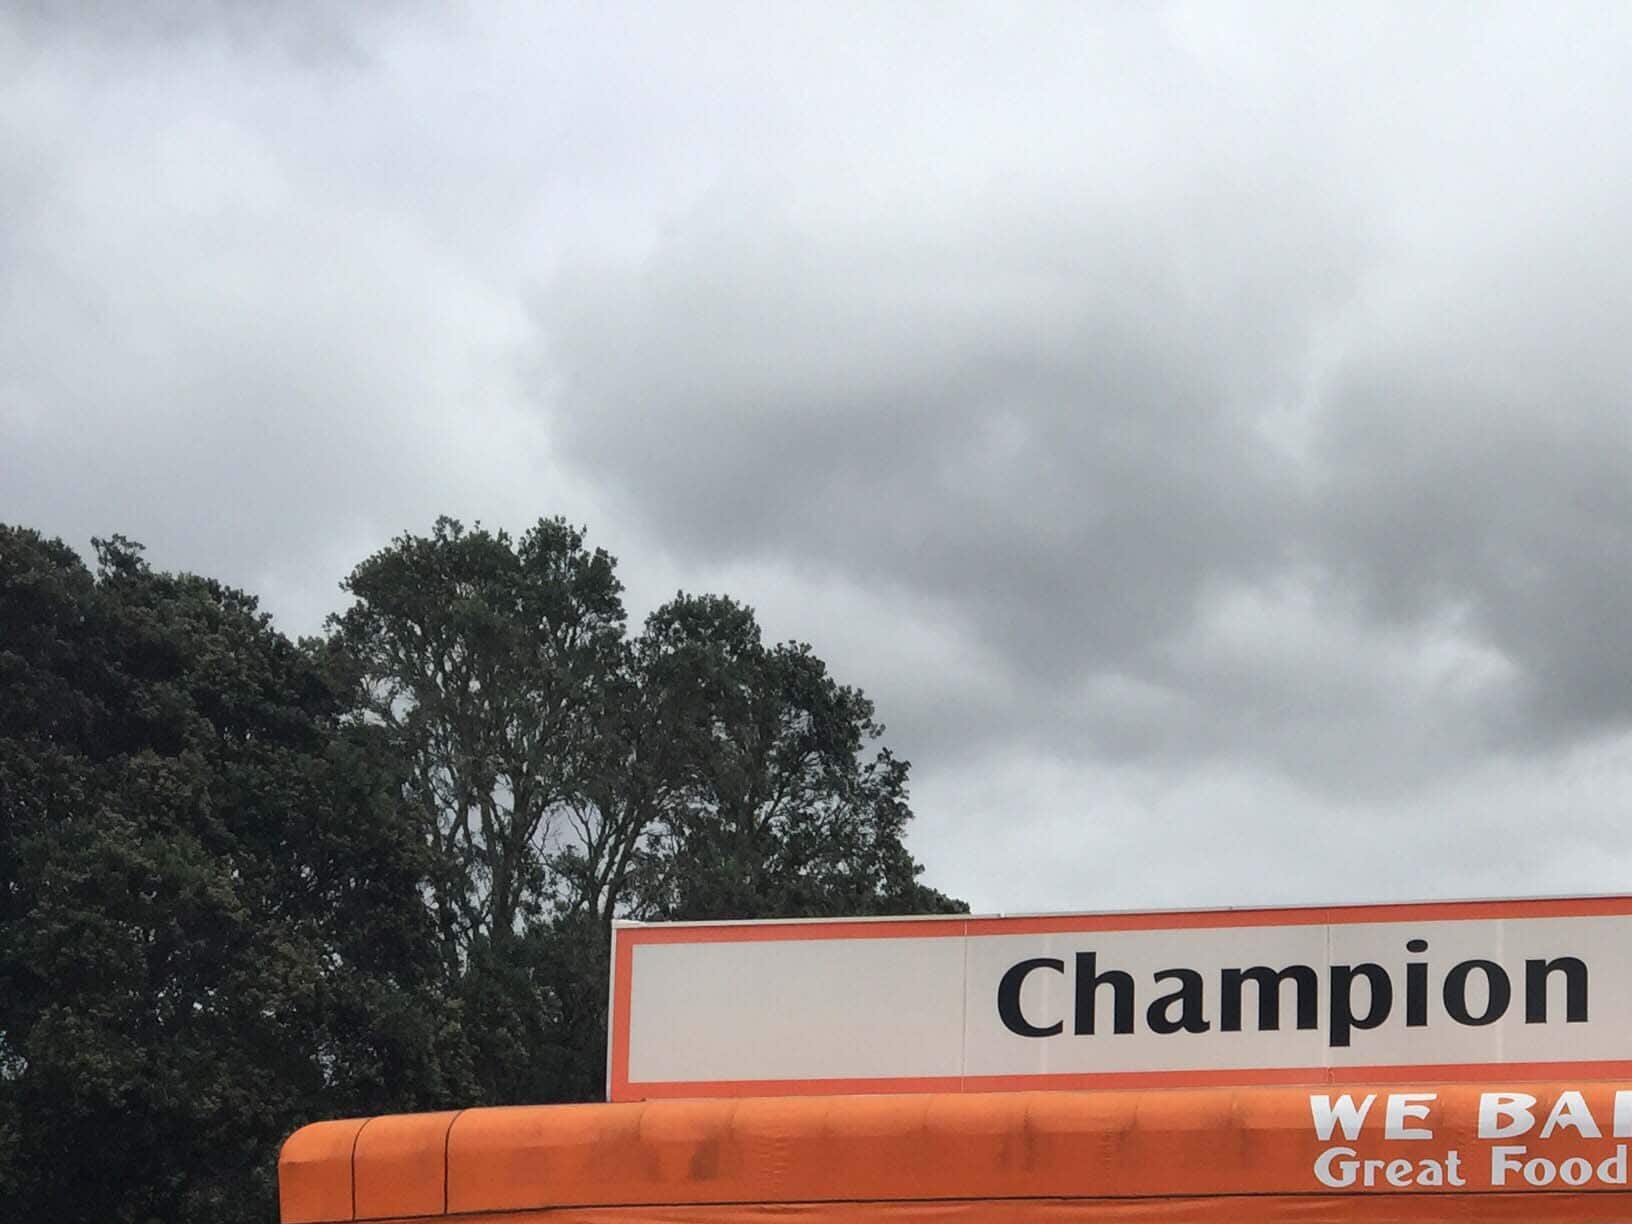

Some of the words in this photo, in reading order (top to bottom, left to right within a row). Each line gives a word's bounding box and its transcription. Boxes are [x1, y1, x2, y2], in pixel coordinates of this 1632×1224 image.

[997, 939, 1588, 1047] Champion
[1309, 1093, 1437, 1141] WE
[1313, 1146, 1466, 1188] Great
[1491, 1144, 1628, 1187] Food
